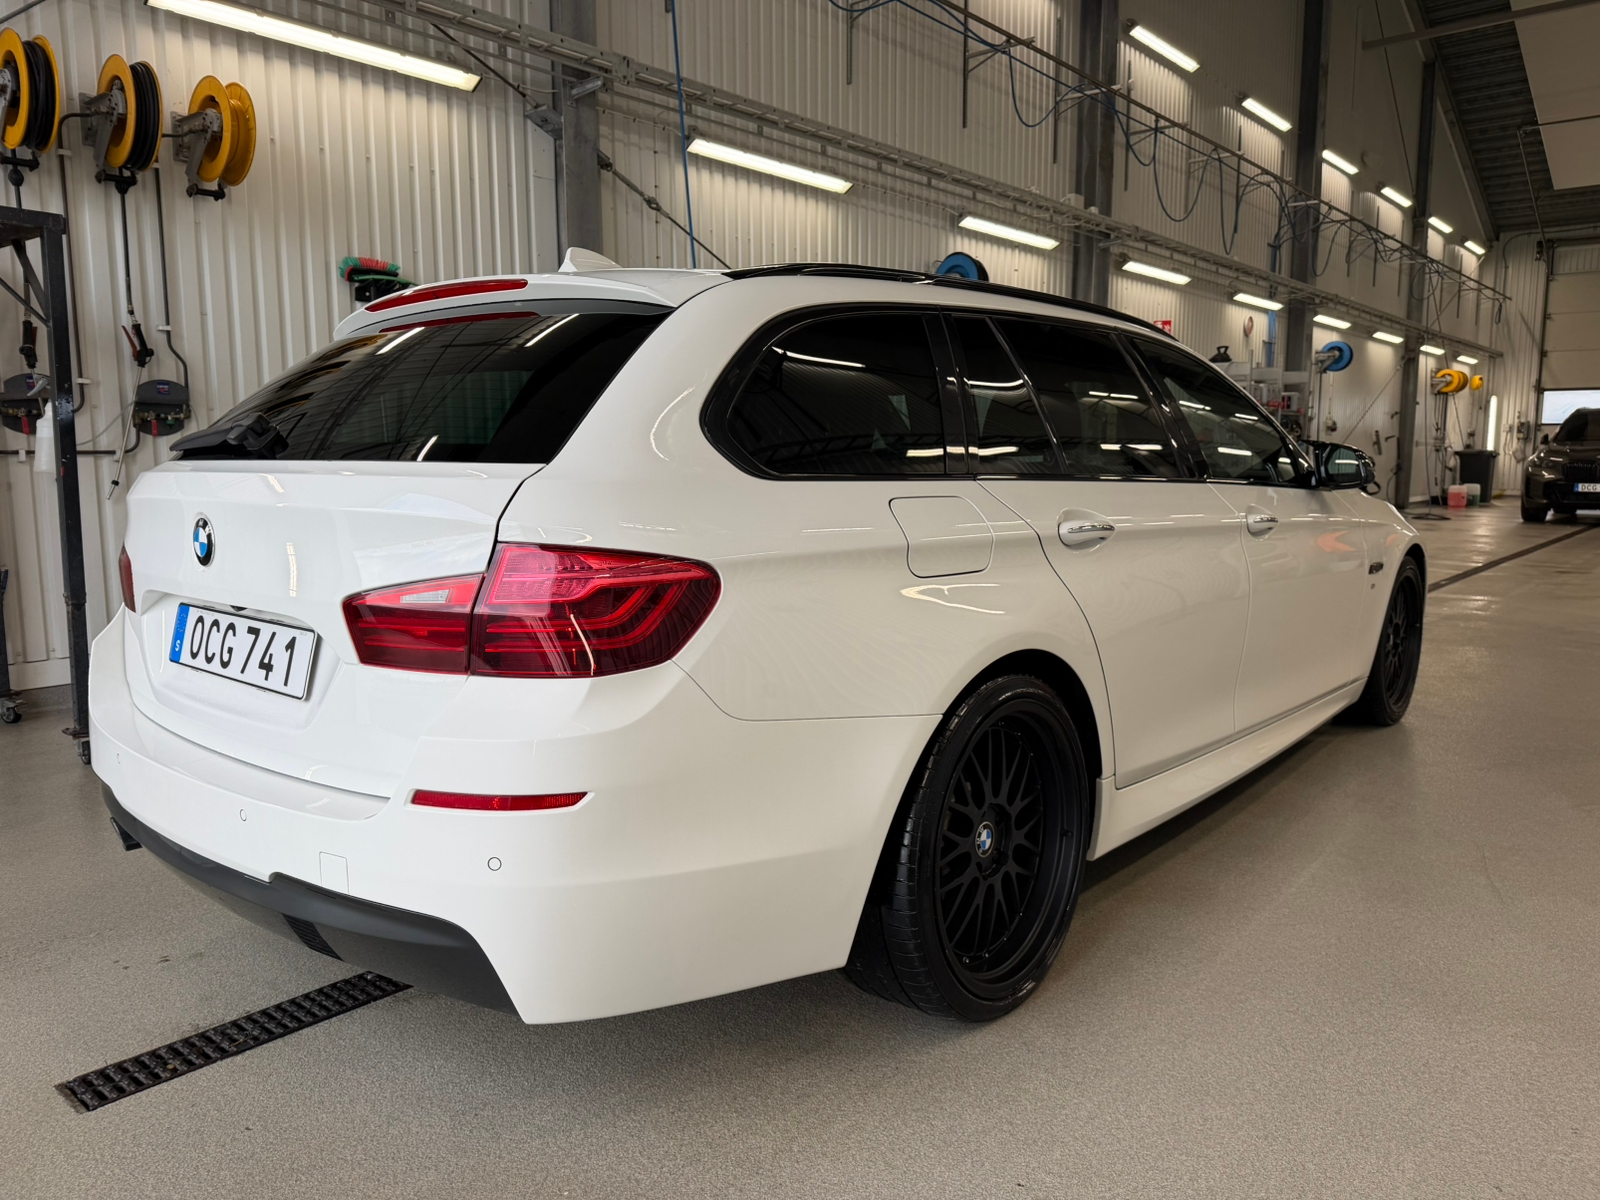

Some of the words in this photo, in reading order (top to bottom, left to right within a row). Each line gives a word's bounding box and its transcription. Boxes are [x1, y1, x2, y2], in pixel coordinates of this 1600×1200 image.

[174, 639, 181, 651] S
[189, 615, 237, 669] OCG
[239, 625, 297, 687] 741
